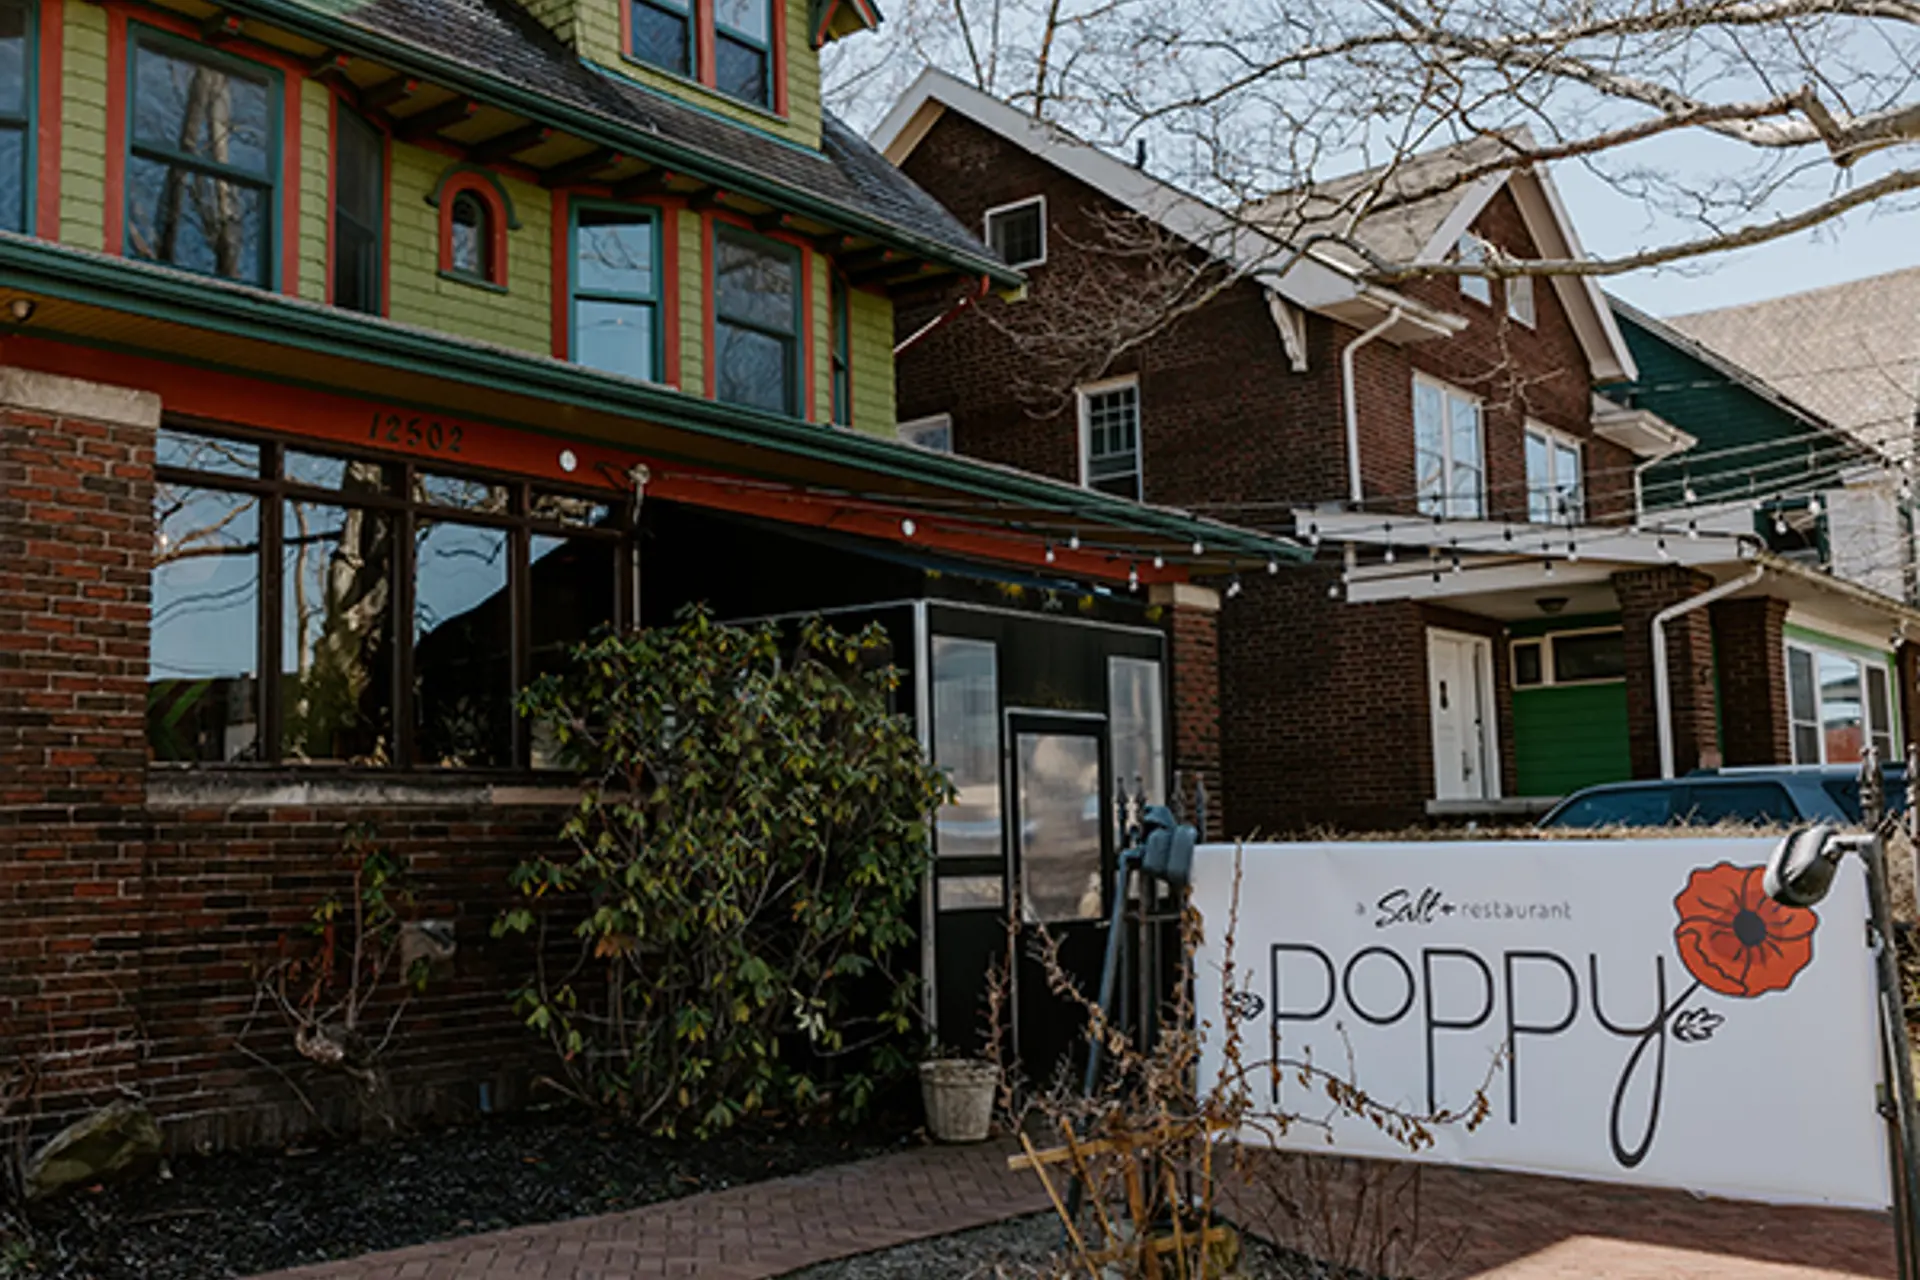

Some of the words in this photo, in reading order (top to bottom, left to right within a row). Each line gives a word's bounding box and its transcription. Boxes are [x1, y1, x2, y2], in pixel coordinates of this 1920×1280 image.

[369, 412, 464, 453] 12502
[1355, 900, 1367, 916] a
[1461, 901, 1573, 921] restaurant
